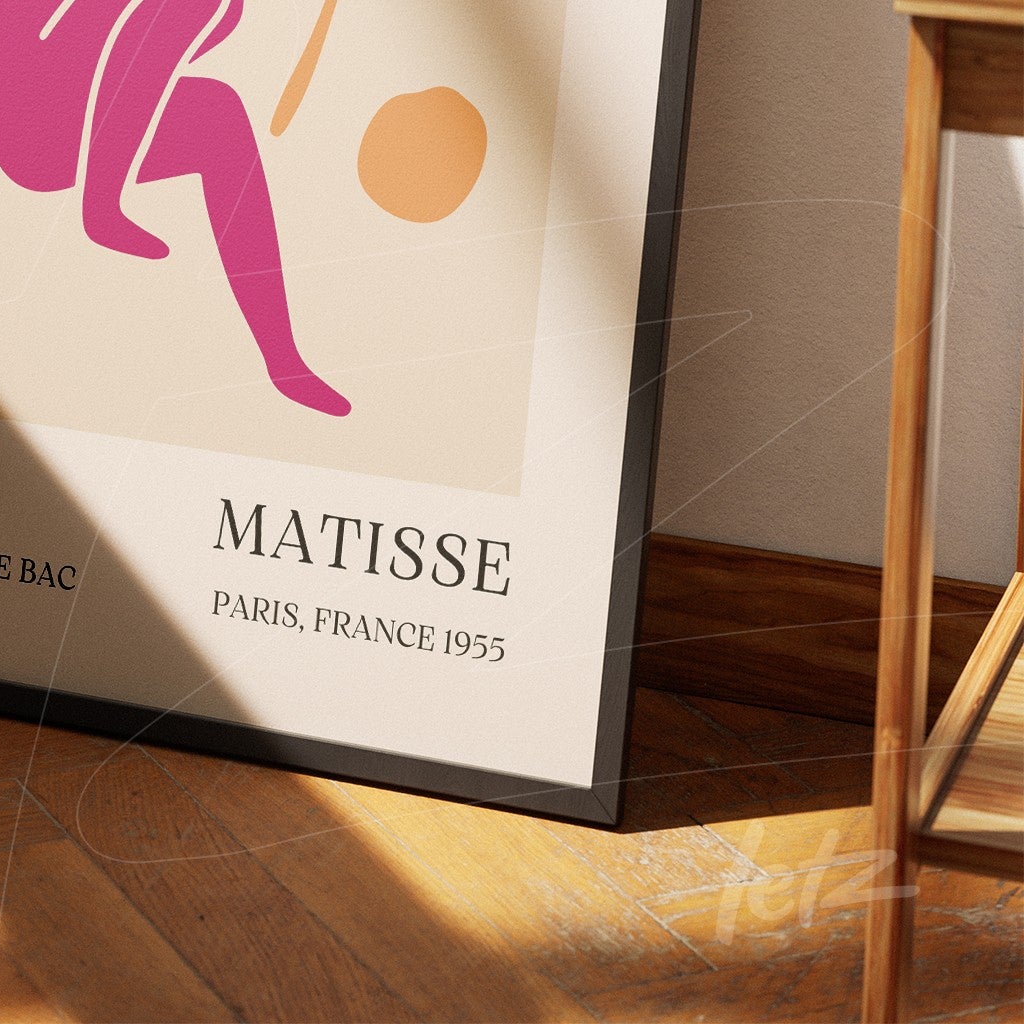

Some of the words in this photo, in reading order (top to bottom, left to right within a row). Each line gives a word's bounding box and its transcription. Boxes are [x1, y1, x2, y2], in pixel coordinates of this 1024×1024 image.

[18, 557, 78, 592] BAC
[212, 497, 512, 597] MATISSE
[211, 589, 305, 634] PARIS,
[313, 607, 435, 652] FRANCE
[443, 628, 506, 663] 1955
